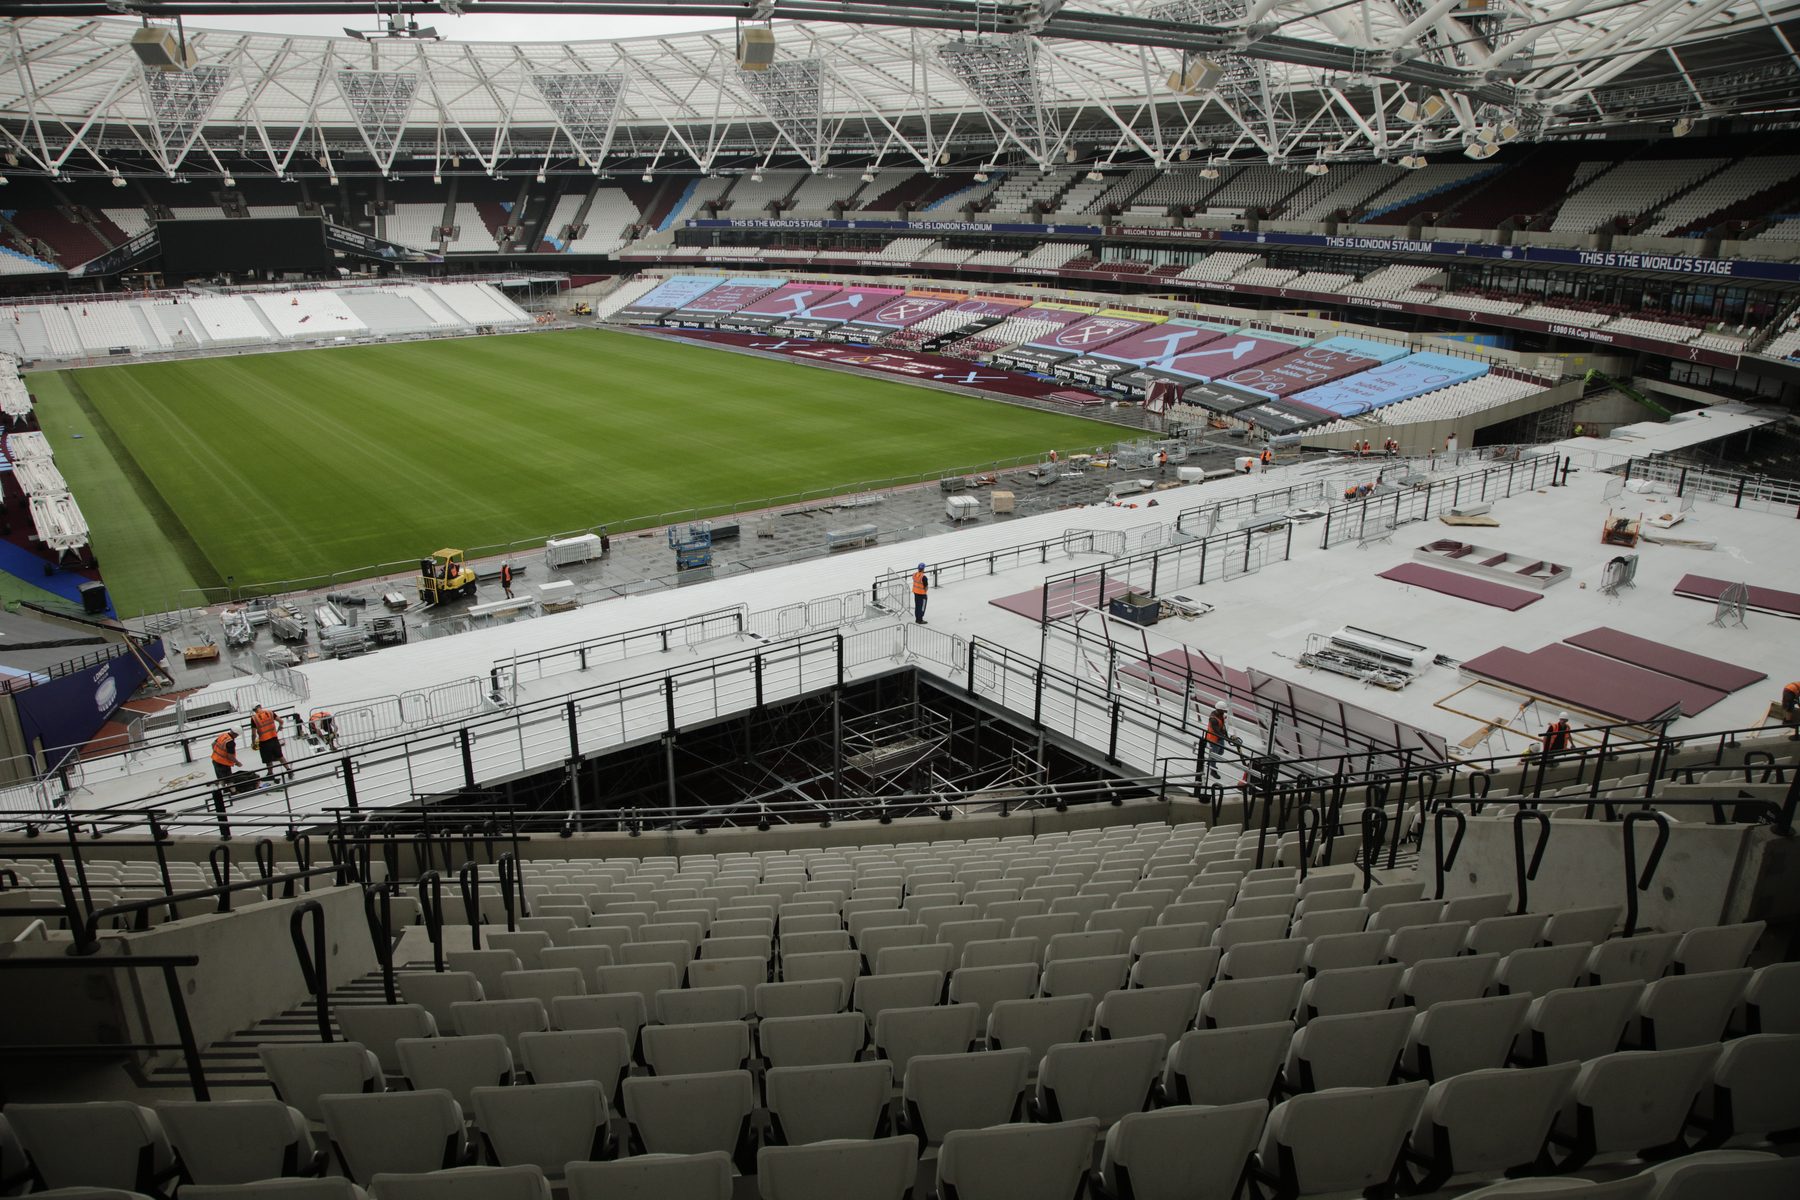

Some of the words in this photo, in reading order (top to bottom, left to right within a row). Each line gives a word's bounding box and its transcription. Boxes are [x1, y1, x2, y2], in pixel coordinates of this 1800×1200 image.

[1326, 237, 1344, 247] THIS
[1346, 238, 1353, 247] IS
[1355, 238, 1391, 250] LONDON
[1392, 241, 1432, 252] STADIUM
[1579, 252, 1603, 264] THIS
[1605, 254, 1615, 266] IS
[1618, 254, 1639, 267] THE
[1641, 256, 1692, 271] WORLD'S
[1694, 260, 1732, 274] STAGE
[1371, 300, 1381, 308] Cup
[1382, 301, 1402, 310] Winners
[1553, 325, 1568, 334] 1980
[1568, 327, 1575, 336] FA
[1576, 329, 1589, 339] Cup
[1590, 331, 1613, 342] Winners
[1073, 372, 1091, 384] betway
[1111, 380, 1129, 394] betway
